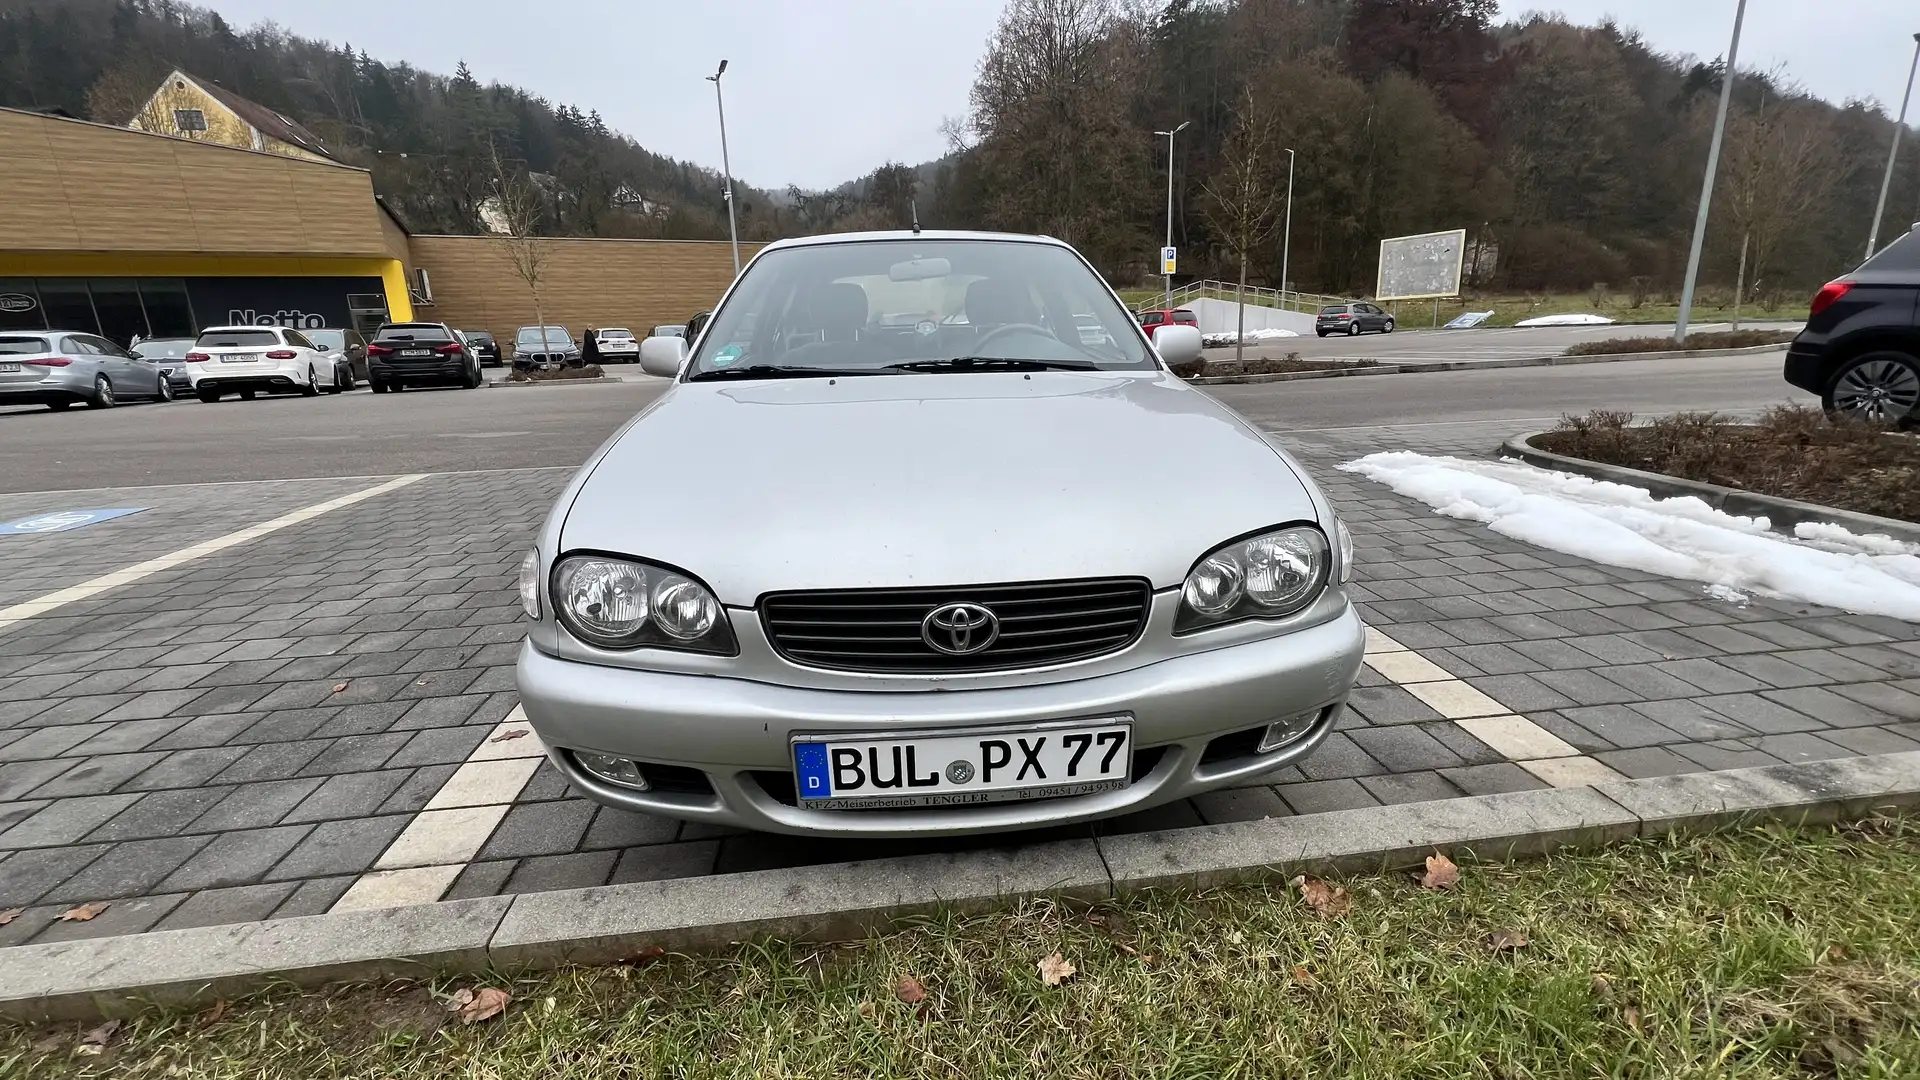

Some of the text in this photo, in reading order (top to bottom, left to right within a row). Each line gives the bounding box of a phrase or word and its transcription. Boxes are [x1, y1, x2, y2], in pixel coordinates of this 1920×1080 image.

[229, 309, 325, 328] Netto
[831, 731, 1126, 790] BUL PX 77
[808, 776, 820, 789] D
[805, 799, 916, 810] KFZ-Meisterbetrieb
[923, 793, 989, 805] TENGLER
